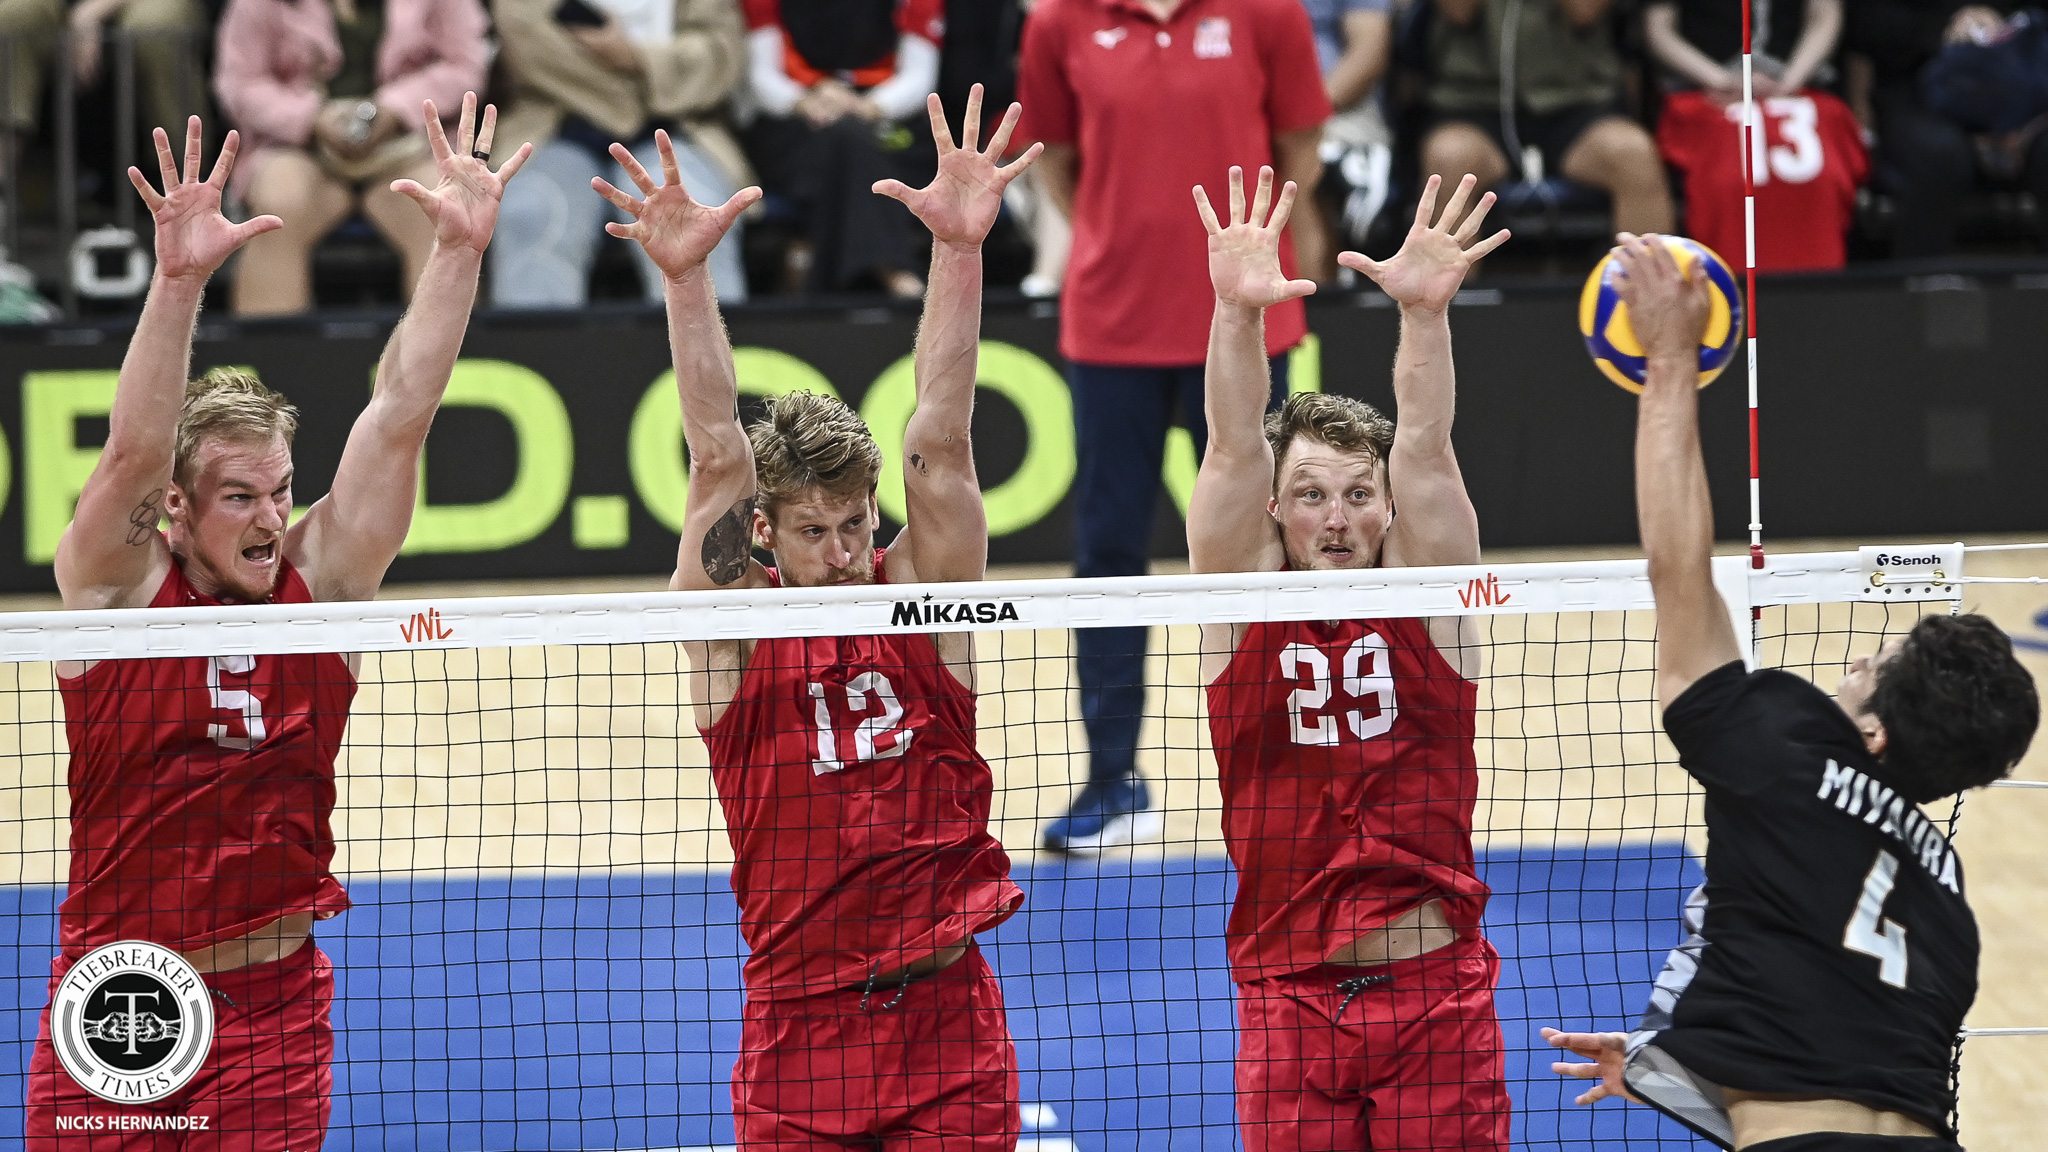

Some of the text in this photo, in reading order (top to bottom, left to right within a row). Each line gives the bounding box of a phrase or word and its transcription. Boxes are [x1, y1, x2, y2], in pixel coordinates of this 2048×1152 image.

[1724, 96, 1825, 187] 13
[1458, 573, 1511, 608] VNL
[1891, 555, 1941, 566] Senoh
[400, 607, 453, 643] VNL
[891, 593, 1019, 626] MIKASA
[207, 655, 266, 751] 5
[808, 671, 914, 776] 12
[1279, 632, 1398, 746] 29
[1817, 758, 1959, 894] MIYAURA
[1843, 849, 1907, 988] 4
